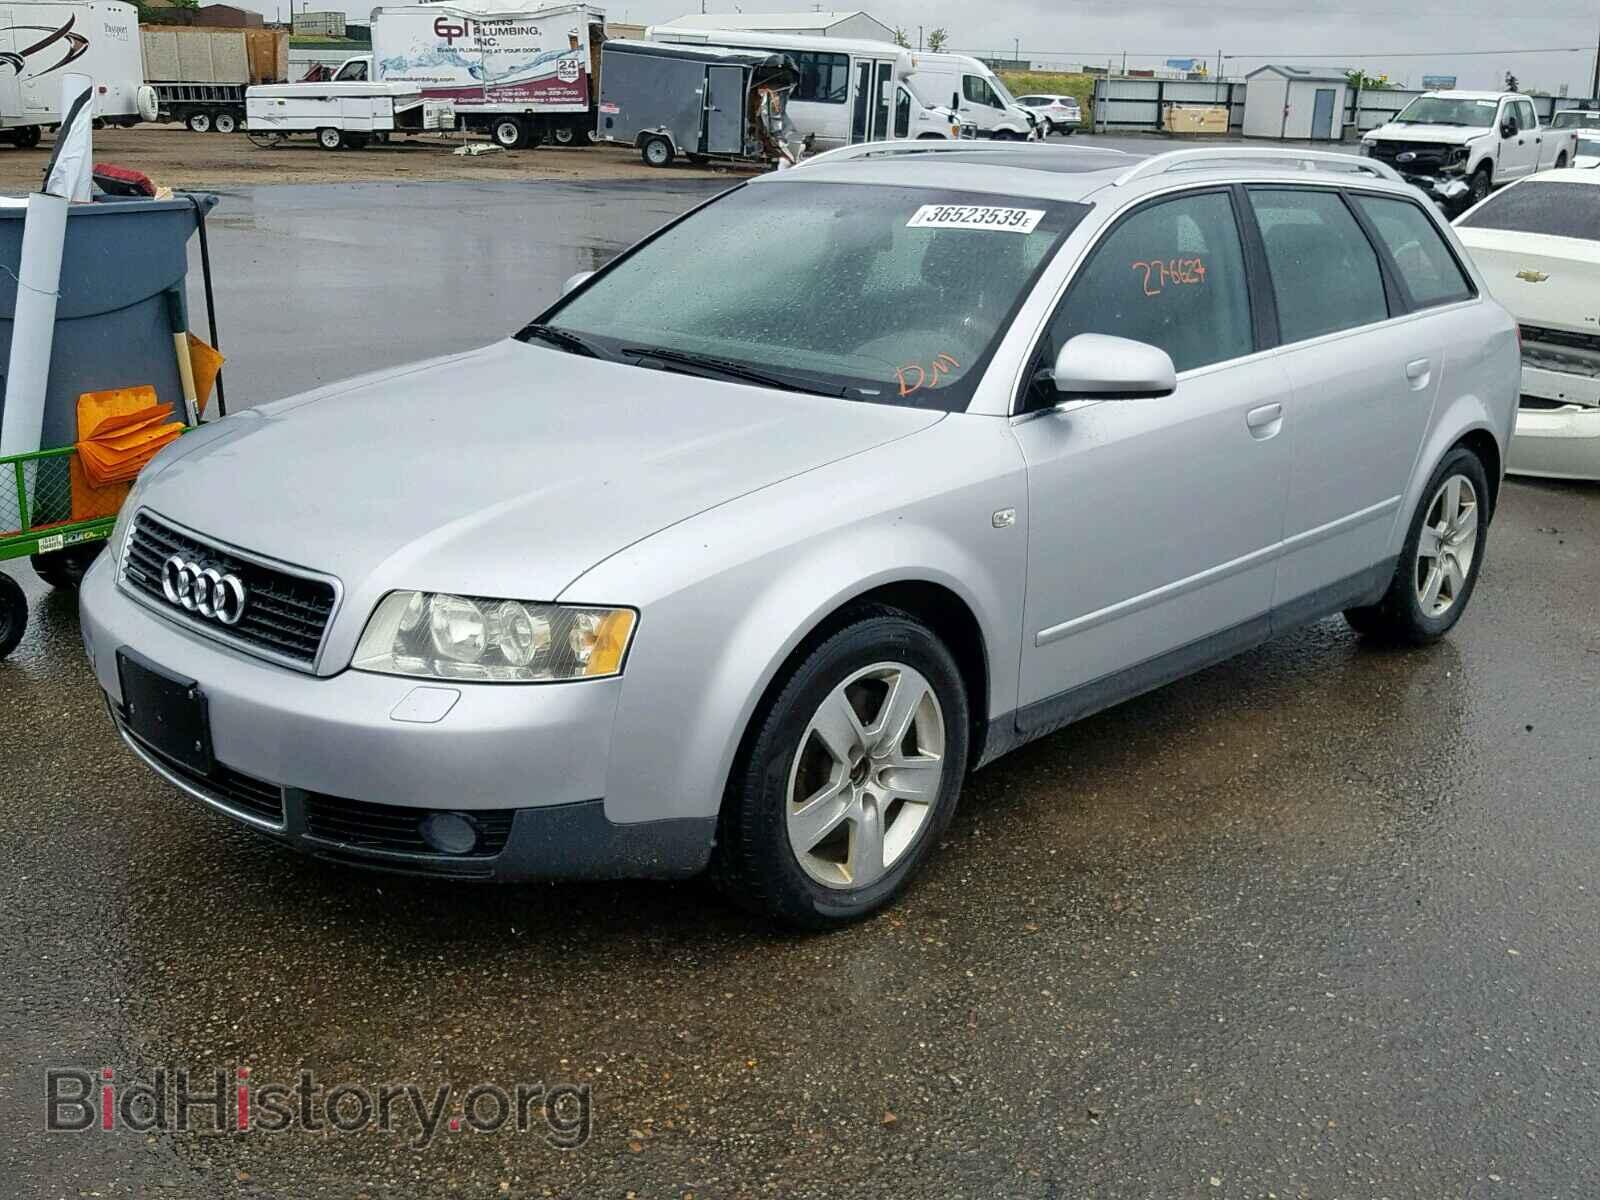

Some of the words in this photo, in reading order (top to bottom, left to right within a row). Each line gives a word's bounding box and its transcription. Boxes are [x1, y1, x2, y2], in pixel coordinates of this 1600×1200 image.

[473, 26, 542, 36] PLUMBING,
[473, 37, 500, 46] INC.
[558, 60, 577, 70] 24
[926, 206, 1026, 227] 36523539
